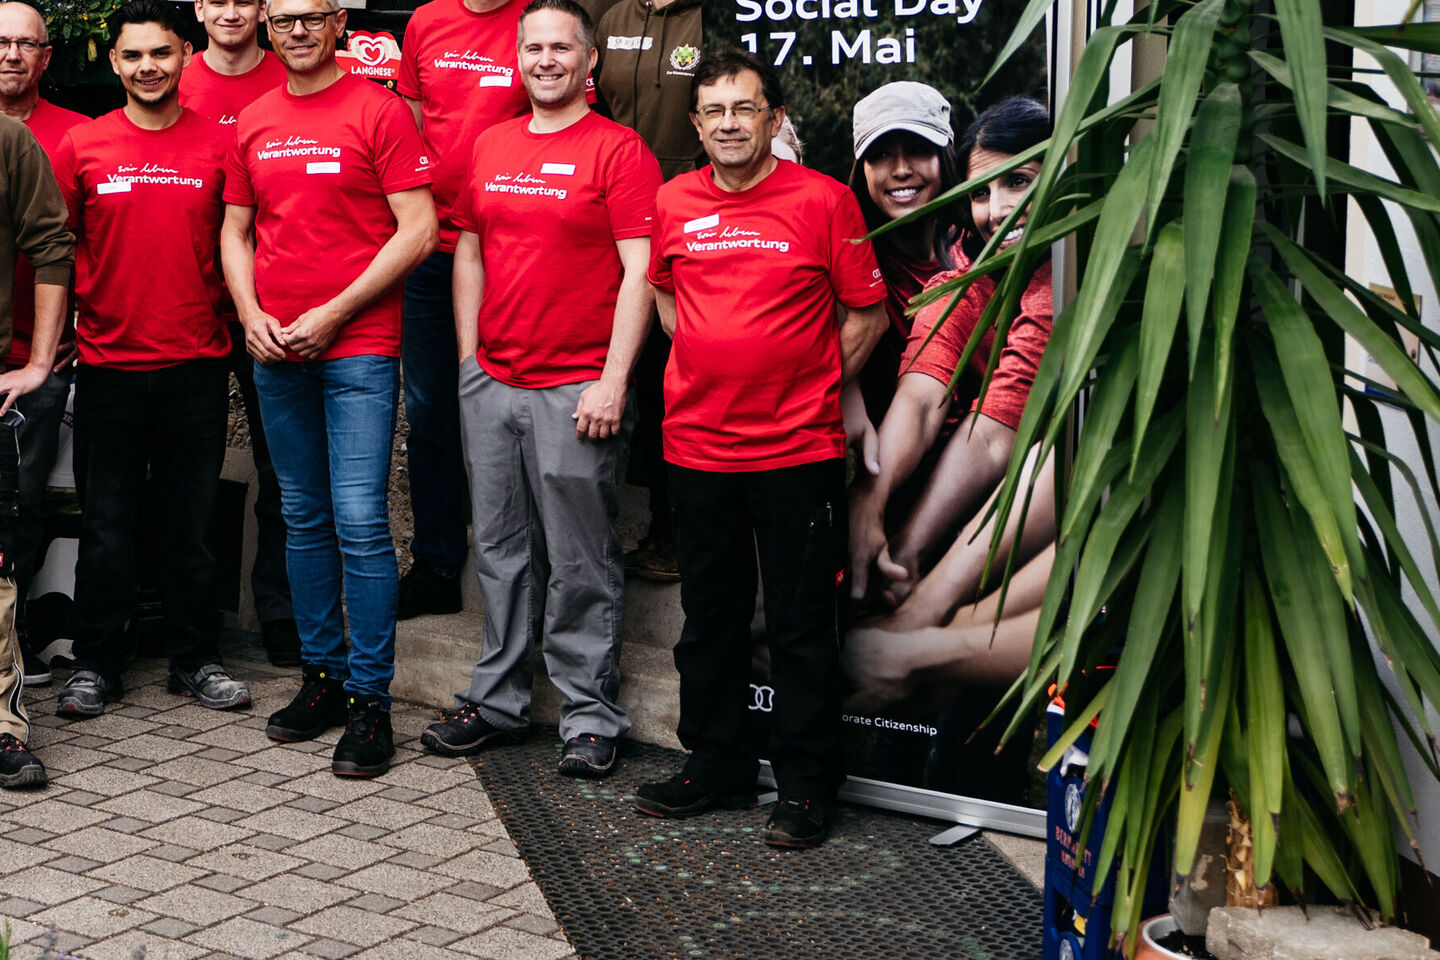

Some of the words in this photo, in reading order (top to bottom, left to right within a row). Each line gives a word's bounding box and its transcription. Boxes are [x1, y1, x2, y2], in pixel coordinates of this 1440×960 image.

[741, 30, 813, 66] 17.
[831, 27, 916, 65] Mai
[351, 65, 392, 77] LANGNESE
[434, 59, 514, 77] Verantwortung
[257, 146, 341, 161] Verantwortung
[107, 174, 203, 189] Verantwortung
[485, 182, 567, 200] Verantwortung
[686, 239, 790, 253] Verantwortung
[842, 714, 872, 726] orate
[874, 717, 938, 737] Citizenship
